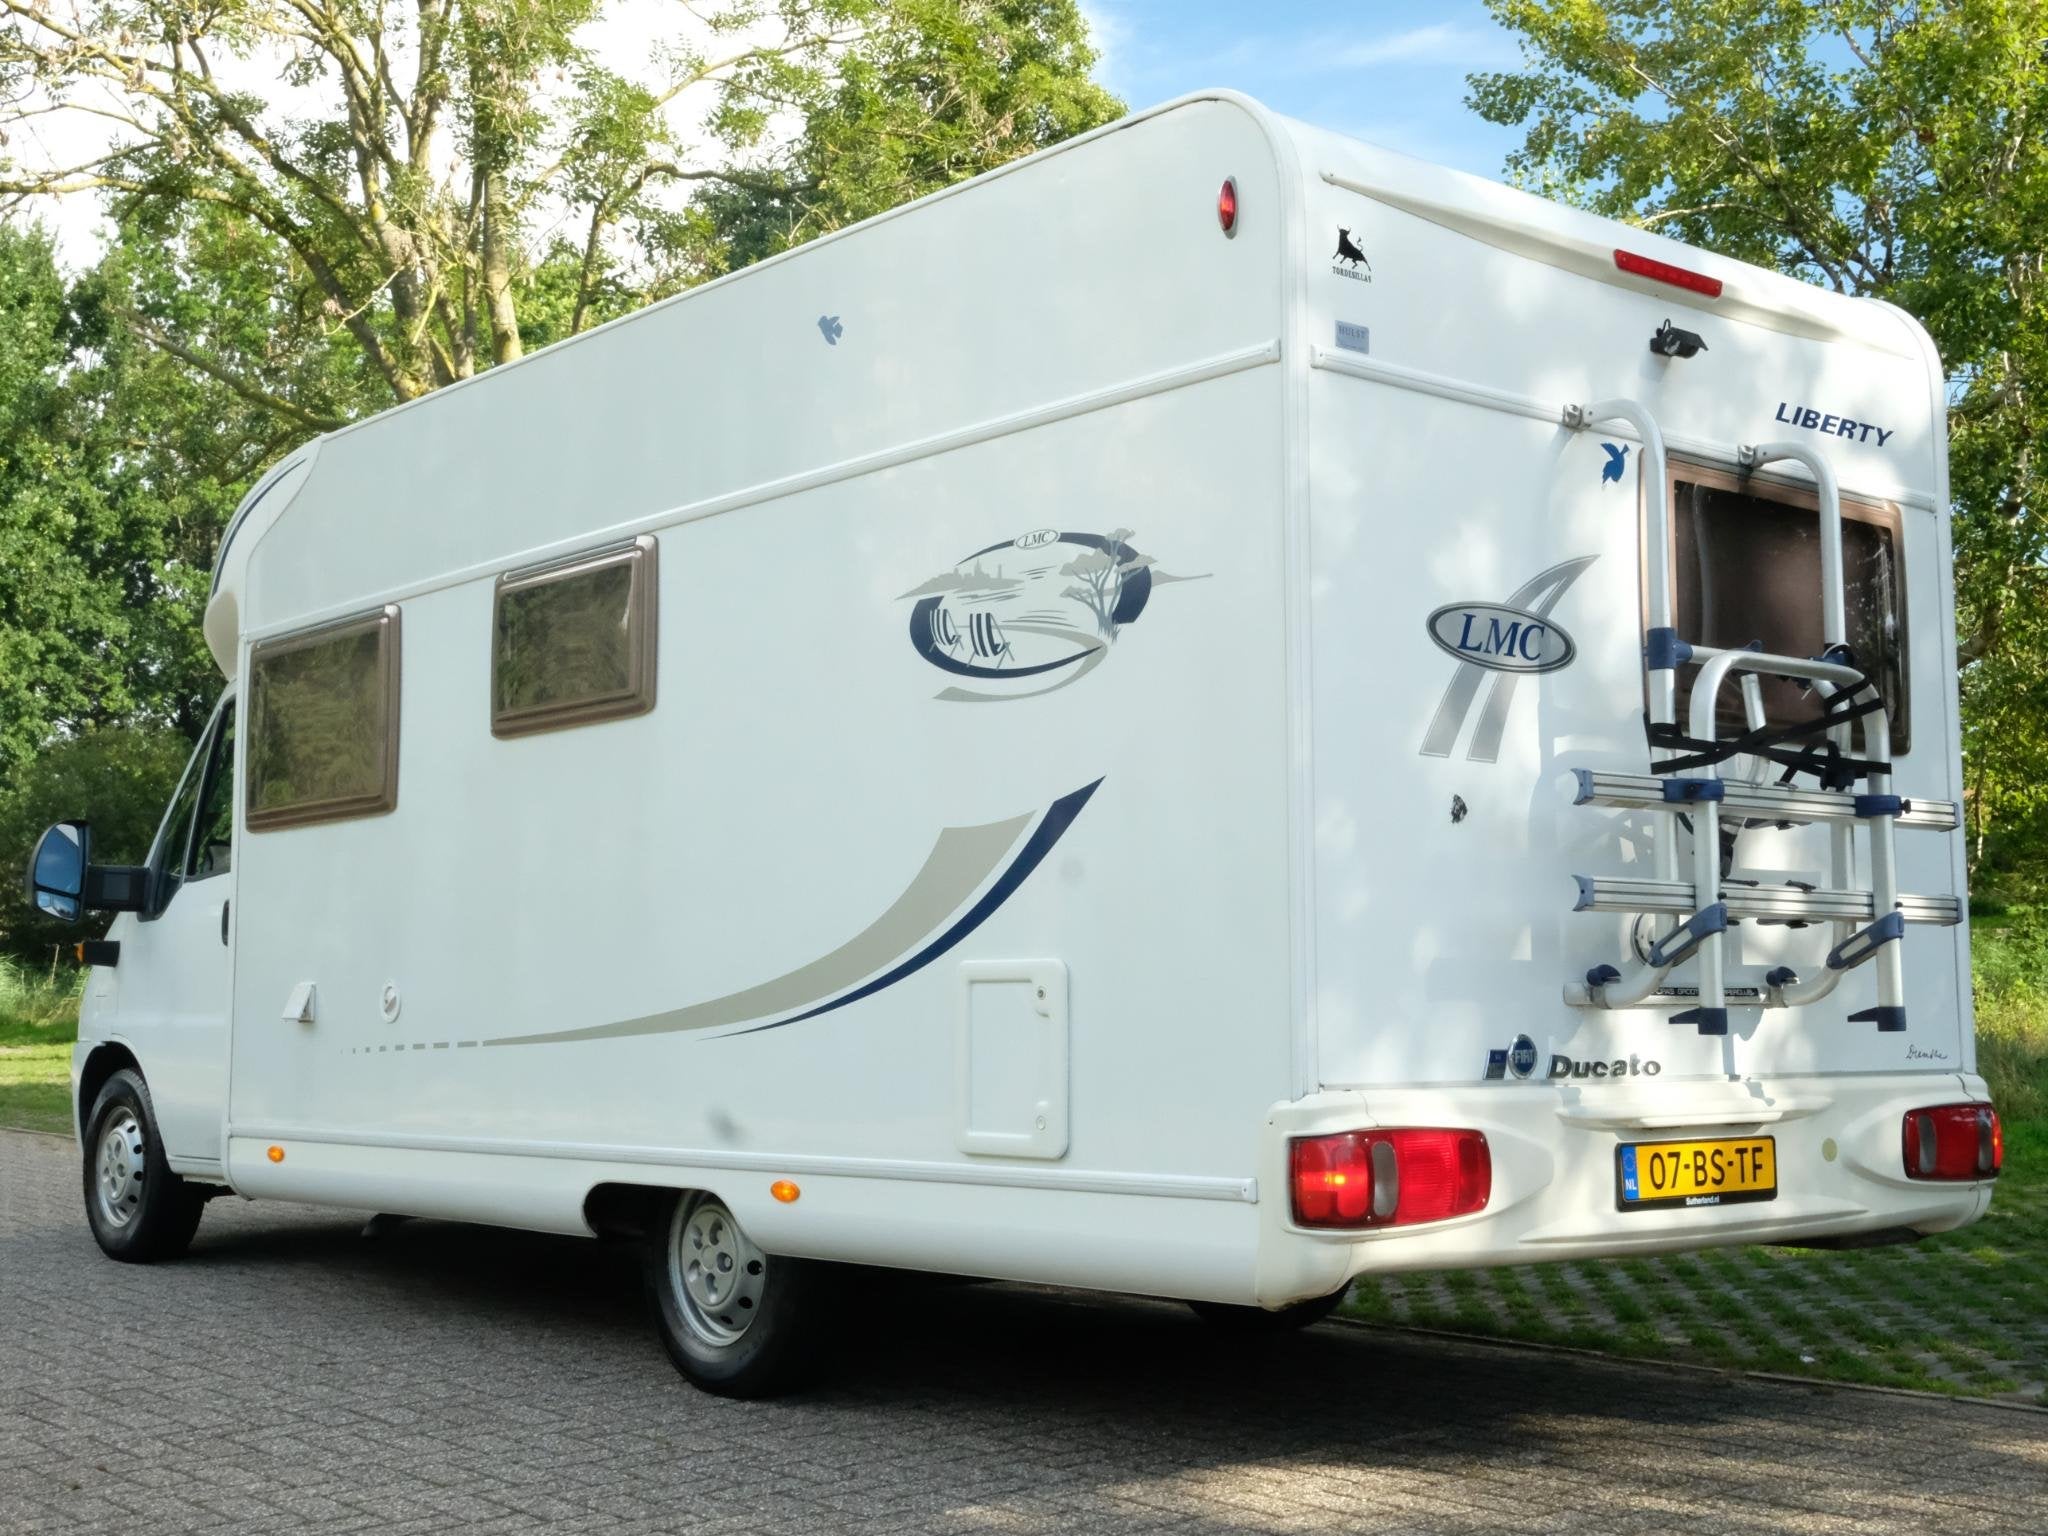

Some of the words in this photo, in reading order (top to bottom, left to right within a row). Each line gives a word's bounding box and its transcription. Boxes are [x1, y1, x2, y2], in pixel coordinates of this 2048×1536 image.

[1775, 402, 1894, 447] LIBERTY
[1024, 531, 1050, 547] LMC
[1457, 613, 1545, 662] LMC
[1547, 1052, 1661, 1080] Ducato
[1625, 1178, 1637, 1190] NL
[1649, 1147, 1763, 1190] 07-BS-TF
